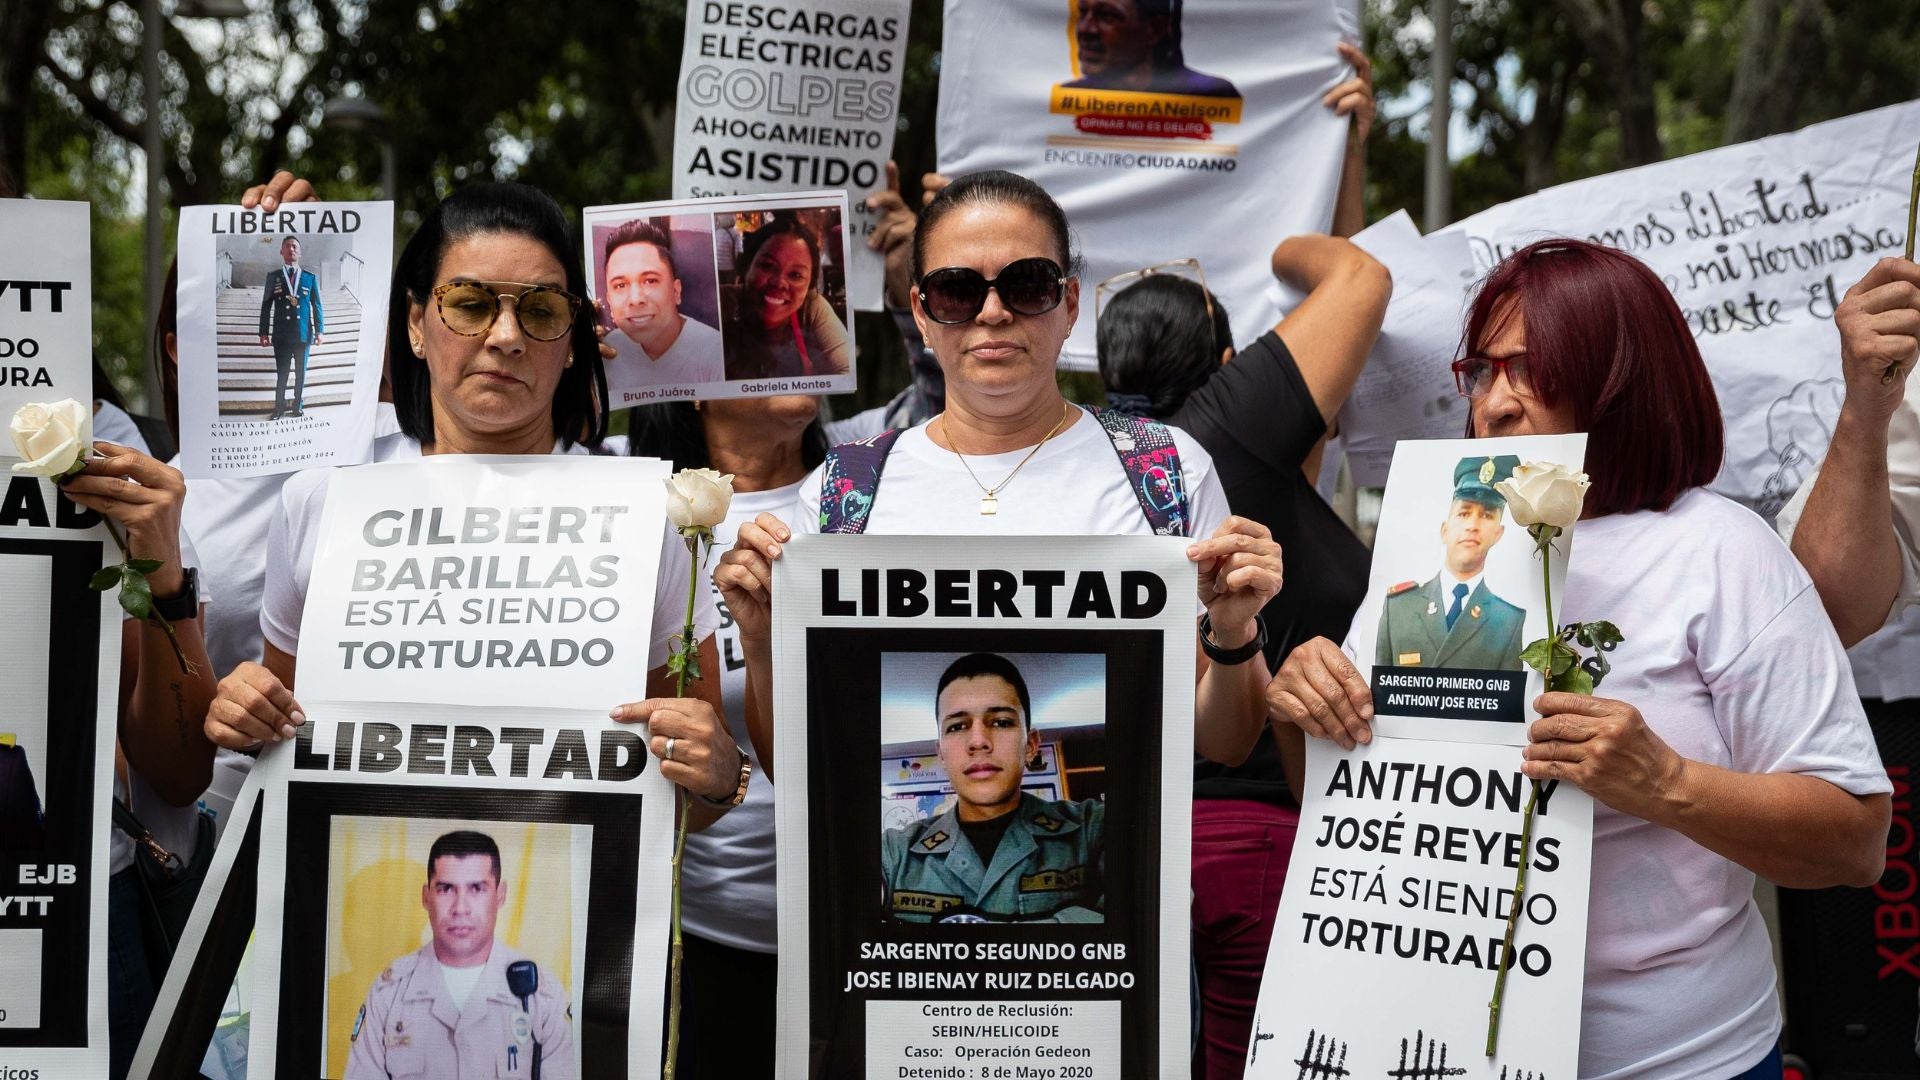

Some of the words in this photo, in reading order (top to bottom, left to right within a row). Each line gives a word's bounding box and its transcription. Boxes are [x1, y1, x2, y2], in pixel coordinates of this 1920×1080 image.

[703, 2, 898, 41] DESCARGAS
[700, 31, 893, 72] ELÉCTRICAS
[686, 64, 896, 123] GOLPES
[1061, 96, 1230, 119] #LiberenANelson
[693, 116, 882, 149] AHOGAMIENTO
[1080, 117, 1125, 130] OPINAR
[1127, 120, 1144, 131] NO
[1146, 121, 1161, 131] ES
[1163, 122, 1203, 134] DELITO
[688, 146, 878, 189] ASISTIDO
[211, 210, 362, 235] LIBERTAD
[1687, 244, 1741, 289] mi
[1738, 224, 1904, 279] Hermosa
[624, 389, 655, 402] Bruno
[659, 386, 696, 398] Juárez
[741, 381, 788, 393] Gabriela
[792, 379, 832, 391] Montes
[211, 461, 257, 469] DETENIDO
[362, 506, 629, 548] GILBERT
[351, 555, 621, 592] BARILLAS
[821, 568, 1168, 620] LIBERTAD
[344, 592, 447, 627] ESTÁ
[459, 596, 621, 625] SIENDO
[338, 637, 615, 670] TORTURADO
[1379, 675, 1434, 688] SARGENTO
[1436, 677, 1482, 690] PRIMERO
[1486, 679, 1510, 692] GNB
[1387, 693, 1439, 707] ANTHONY
[1440, 696, 1465, 710] JOSE
[1467, 697, 1499, 710] REYES
[293, 720, 648, 782] LIBERTAD
[1316, 812, 1404, 855] JOSÉ
[1414, 823, 1561, 873] REYES
[19, 863, 77, 885] EJB
[901, 895, 936, 909] RUIZ
[1310, 865, 1388, 905] ESTÁ
[1398, 876, 1557, 926] SIENDO
[860, 942, 970, 960] SARGENTO
[976, 943, 1076, 960] SEGUNDO
[1082, 943, 1126, 960] GNB
[1301, 912, 1553, 977] TORTURADO
[844, 971, 891, 992] JOSE
[898, 972, 980, 989] IBIENAY
[985, 972, 1032, 989] RUIZ
[1038, 971, 1135, 989] DELGADO
[922, 1004, 972, 1017] Centro
[976, 1004, 994, 1017] de
[999, 1003, 1073, 1017] Reclusión:
[932, 1025, 1060, 1038] SEBIN/HELICOIDE
[904, 1046, 943, 1058] Caso:
[955, 1045, 1031, 1061] Operación
[1035, 1045, 1091, 1058] Gedeon
[898, 1066, 966, 1079] Detenido
[981, 1066, 990, 1078] 8
[993, 1066, 1012, 1078] de
[1016, 1066, 1055, 1080] Mayo
[1059, 1066, 1093, 1078] 2020
